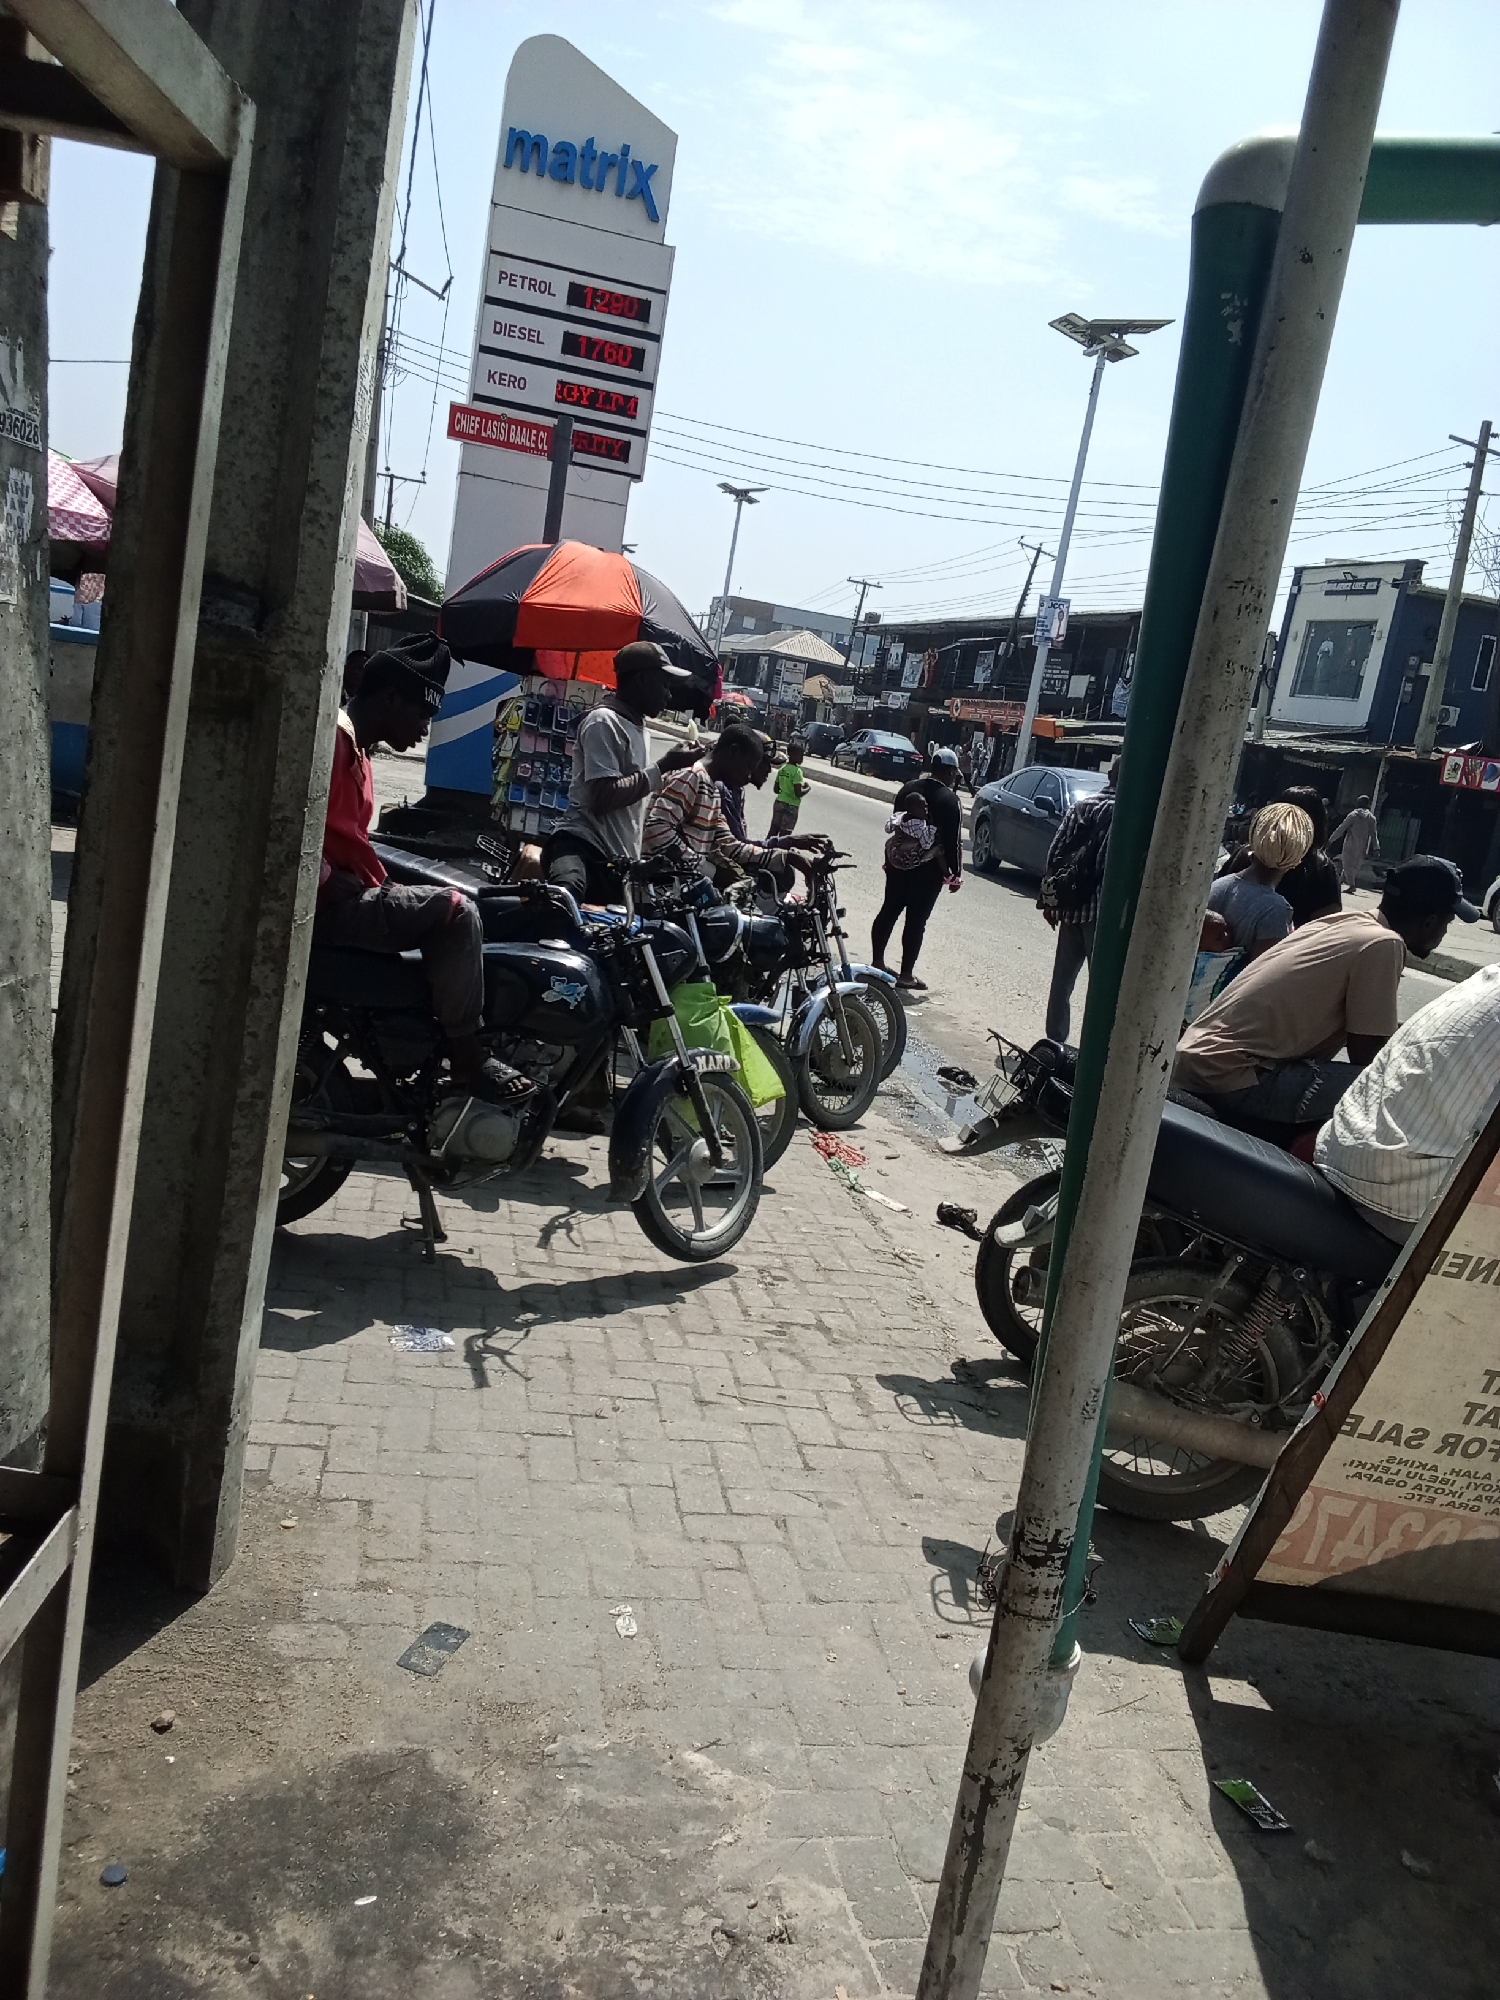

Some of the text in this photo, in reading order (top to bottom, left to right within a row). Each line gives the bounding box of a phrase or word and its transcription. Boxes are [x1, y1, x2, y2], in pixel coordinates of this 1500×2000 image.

[503, 126, 660, 222] matrix
[498, 270, 557, 297] PETROL
[583, 285, 639, 318] 1290
[493, 320, 545, 345] DIESEL
[578, 335, 633, 367] 1760
[487, 368, 527, 391] KERO
[454, 411, 548, 451] CHIEF LASISI BAALE CL
